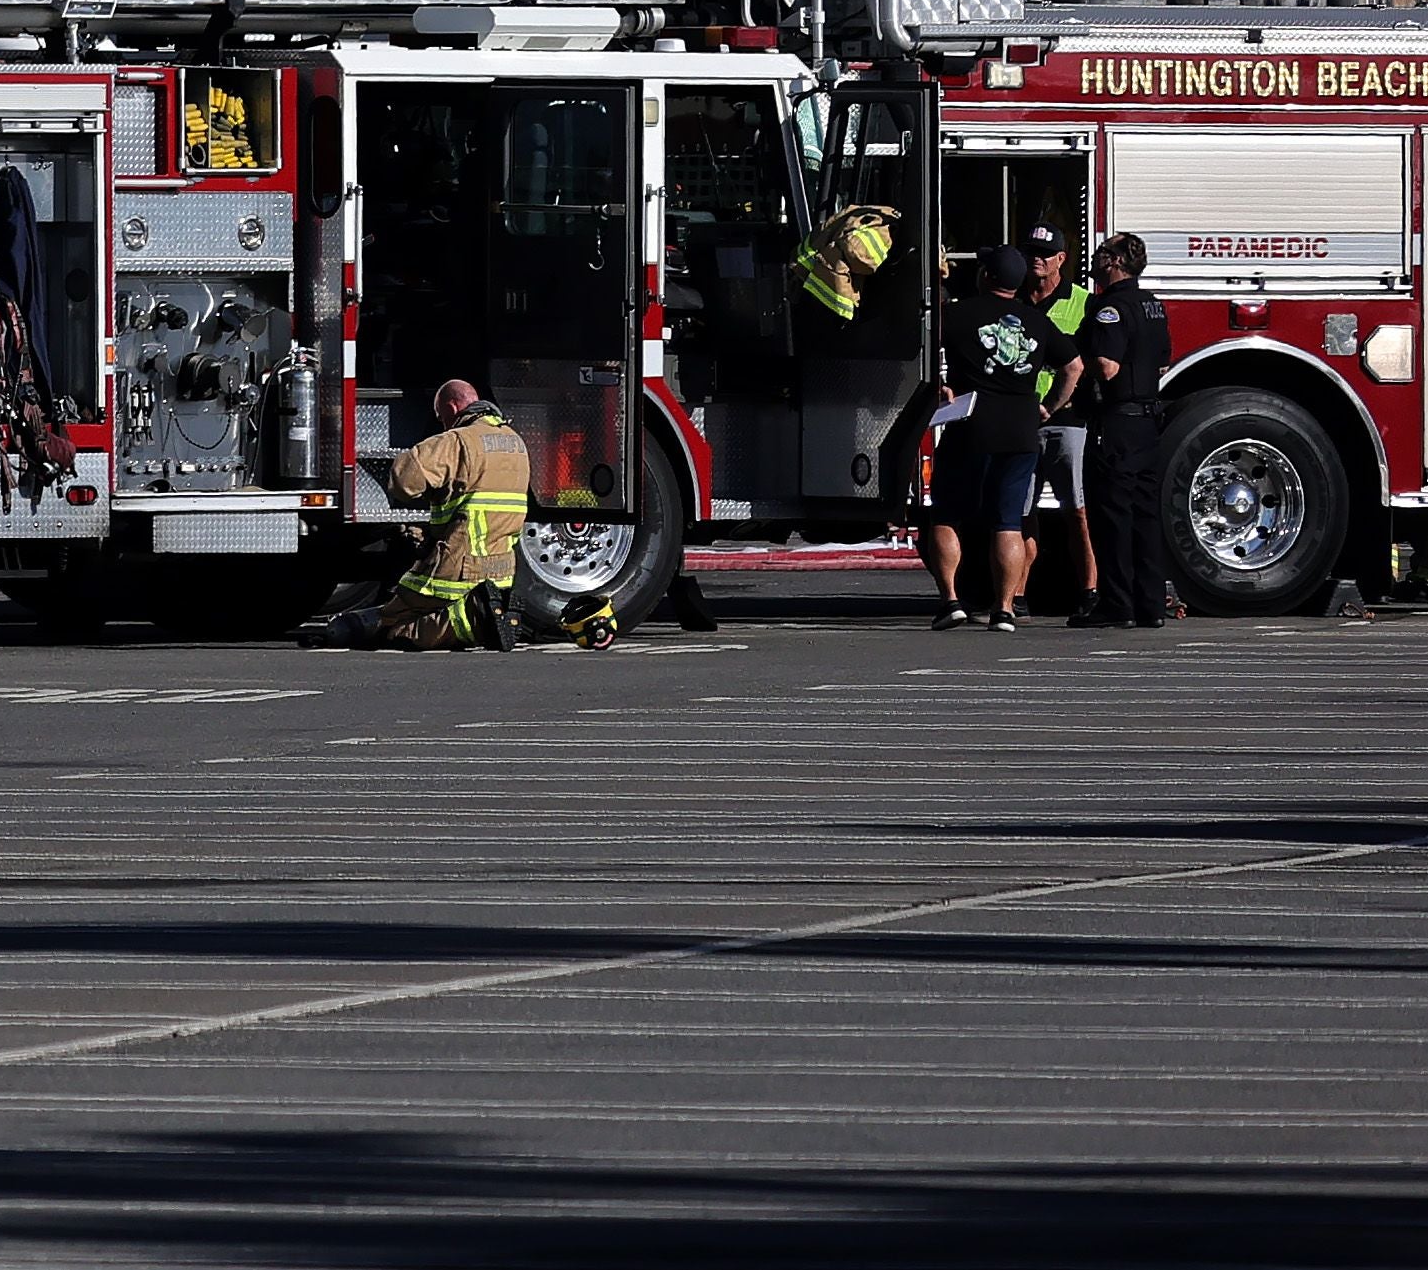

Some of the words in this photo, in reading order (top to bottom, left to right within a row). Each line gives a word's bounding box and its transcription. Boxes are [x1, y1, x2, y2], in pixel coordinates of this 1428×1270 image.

[1081, 58, 1300, 97] HUNTINGTON
[1317, 60, 1428, 97] BEACH
[1187, 236, 1331, 260] PARAMEDIC
